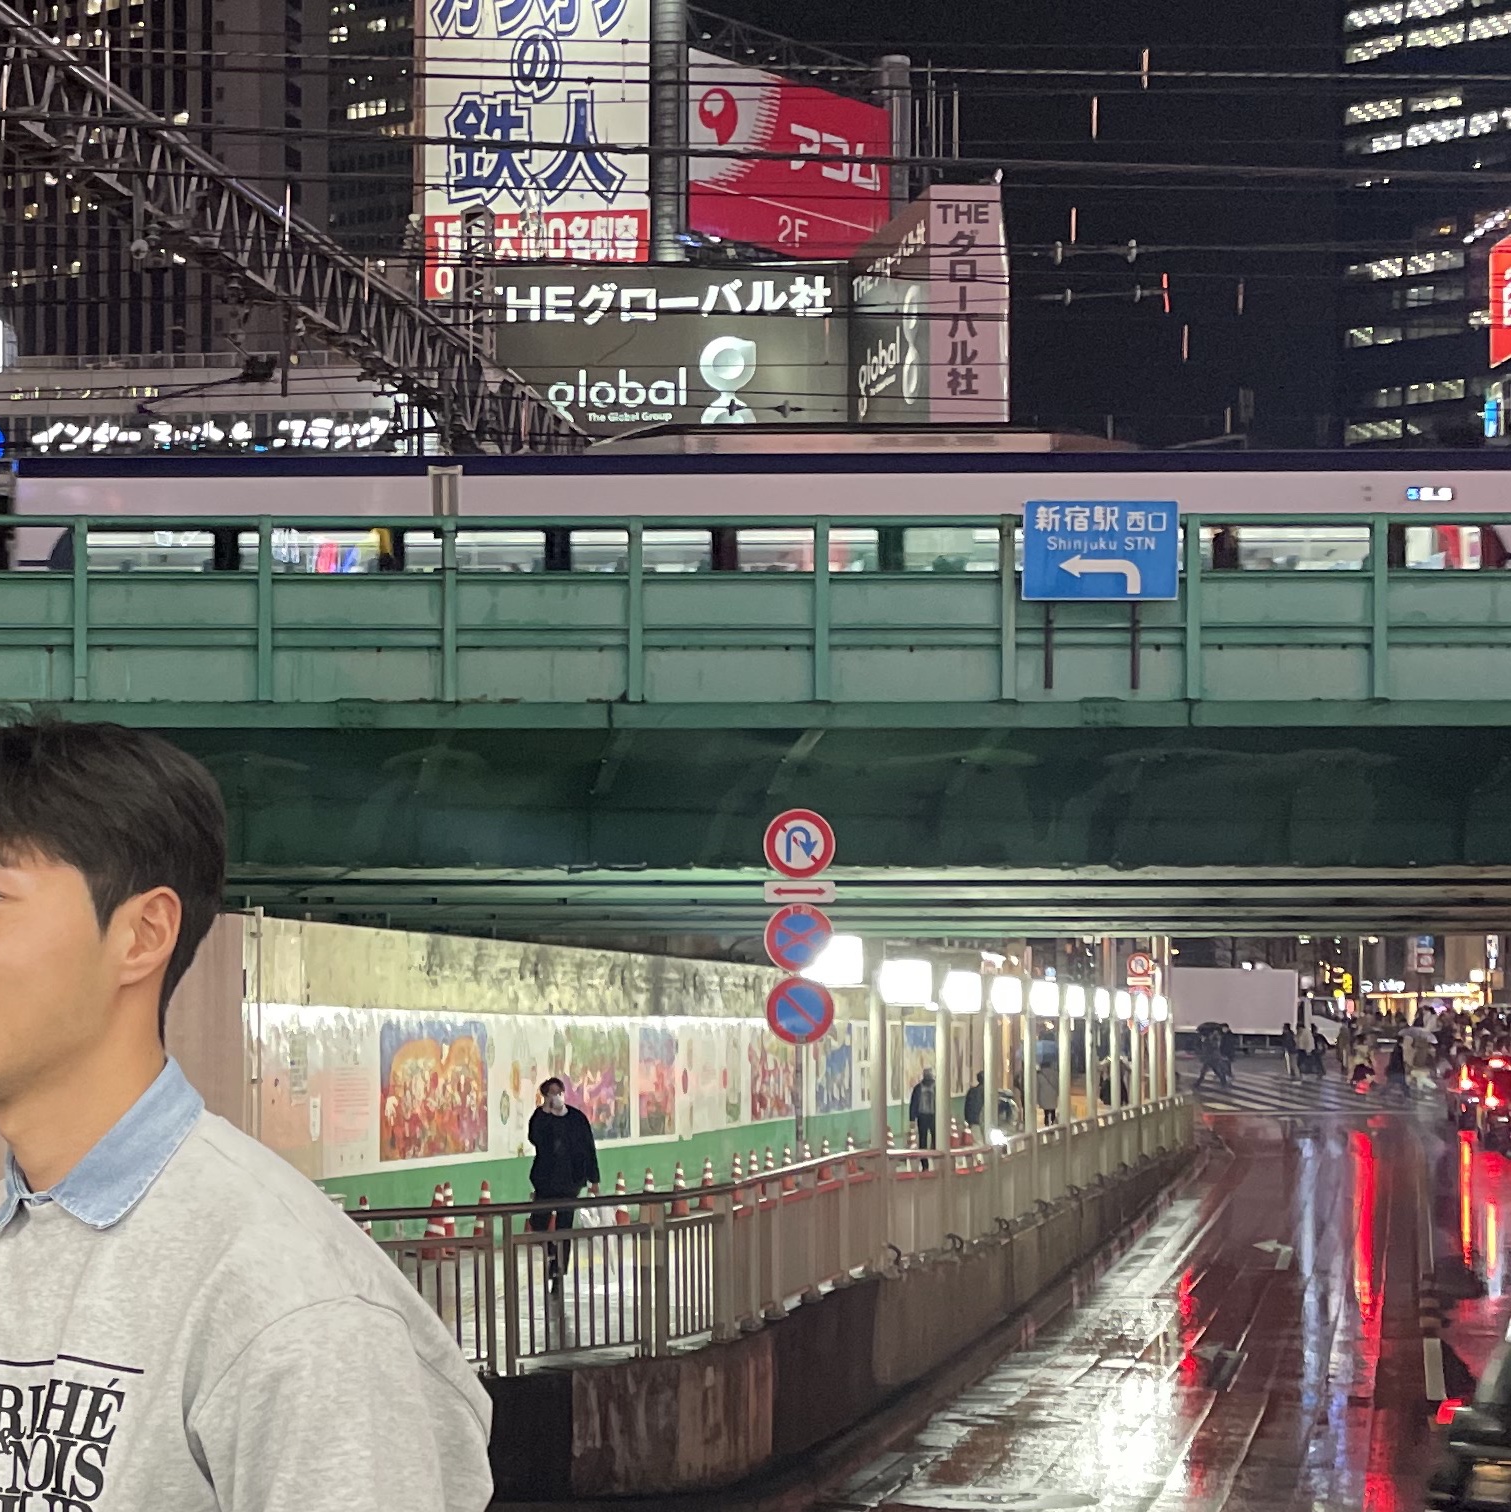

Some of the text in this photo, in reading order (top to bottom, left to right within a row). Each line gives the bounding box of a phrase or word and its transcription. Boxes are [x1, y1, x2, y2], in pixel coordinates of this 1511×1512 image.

[512, 26, 562, 104] の
[445, 88, 628, 207] 鉄人
[790, 122, 881, 192] アコム
[777, 214, 809, 248] 2F
[936, 203, 990, 225] THE
[547, 366, 687, 423] global
[1034, 505, 1167, 532] 新宿駅 西口
[1046, 536, 1157, 554] Shinjuku STN
